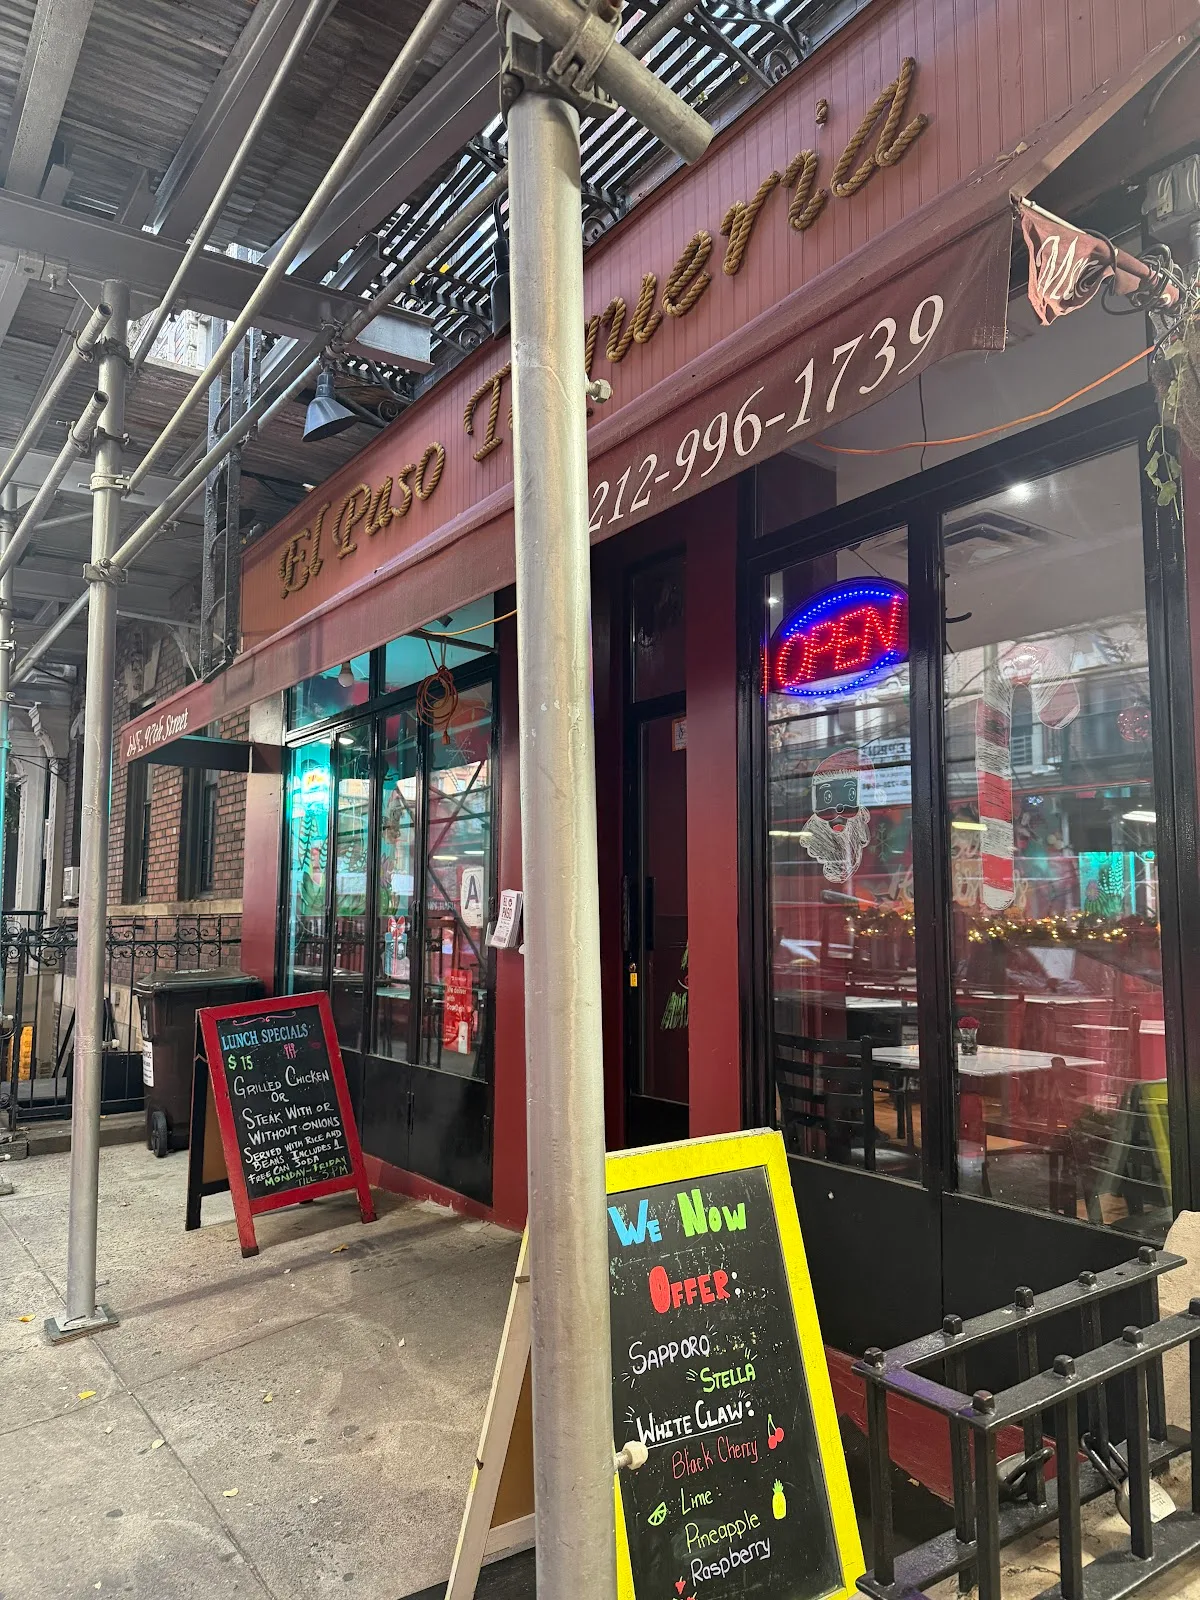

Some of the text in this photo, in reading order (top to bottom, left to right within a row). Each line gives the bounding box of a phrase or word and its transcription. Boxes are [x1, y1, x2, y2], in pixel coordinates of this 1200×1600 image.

[588, 295, 944, 533] 212-996-1739
[278, 502, 331, 599] El
[332, 440, 445, 560] Paso
[777, 594, 904, 686] OPEN
[145, 715, 164, 748] 97th
[162, 707, 189, 741] Street
[464, 875, 480, 910] A
[221, 1023, 309, 1050] LUNCH SPECIALS
[233, 1065, 330, 1099] GRILLED CHICKEN
[270, 1091, 289, 1103] OR
[242, 1102, 334, 1130] STEAK WITH OR
[247, 1116, 341, 1146] WITHOUT ONIONS
[243, 1129, 342, 1164] SERVED WITH RICE AND
[290, 1144, 332, 1161] INCLUDES
[333, 1138, 345, 1151] 1
[247, 1155, 320, 1185] FREE CAN SODA
[608, 1188, 747, 1247] WE NOW
[648, 1265, 742, 1314] OFFER:
[628, 1334, 710, 1375] SAPPORO
[700, 1362, 756, 1393] STELLA
[636, 1412, 693, 1445] WHITE
[671, 1435, 759, 1480] Black Cherry
[680, 1487, 714, 1516] Lime
[684, 1510, 761, 1553] Pineapple
[690, 1537, 771, 1587] Raspberry
